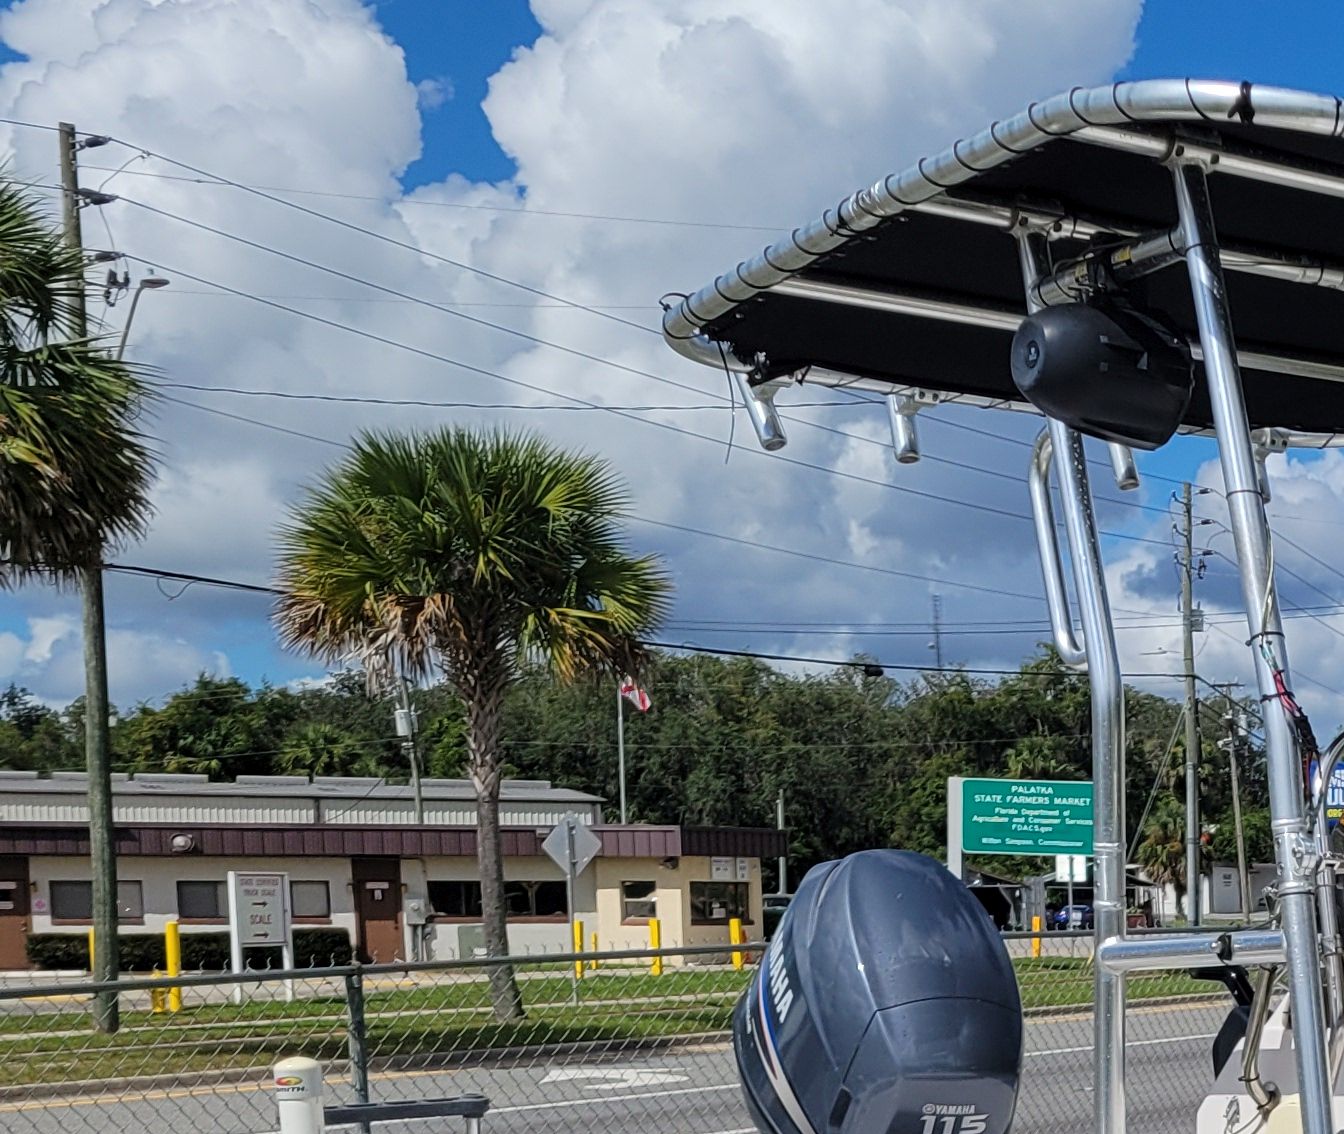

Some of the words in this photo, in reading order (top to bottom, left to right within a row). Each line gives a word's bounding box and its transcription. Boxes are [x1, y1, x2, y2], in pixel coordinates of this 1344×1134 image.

[1011, 785, 1054, 795] PALATKA
[974, 795, 1003, 803] STATE
[1006, 796, 1050, 805] FARMERS
[1054, 797, 1091, 807] MARKET
[250, 914, 272, 925] SCALE
[936, 1104, 976, 1115] YAMAHA
